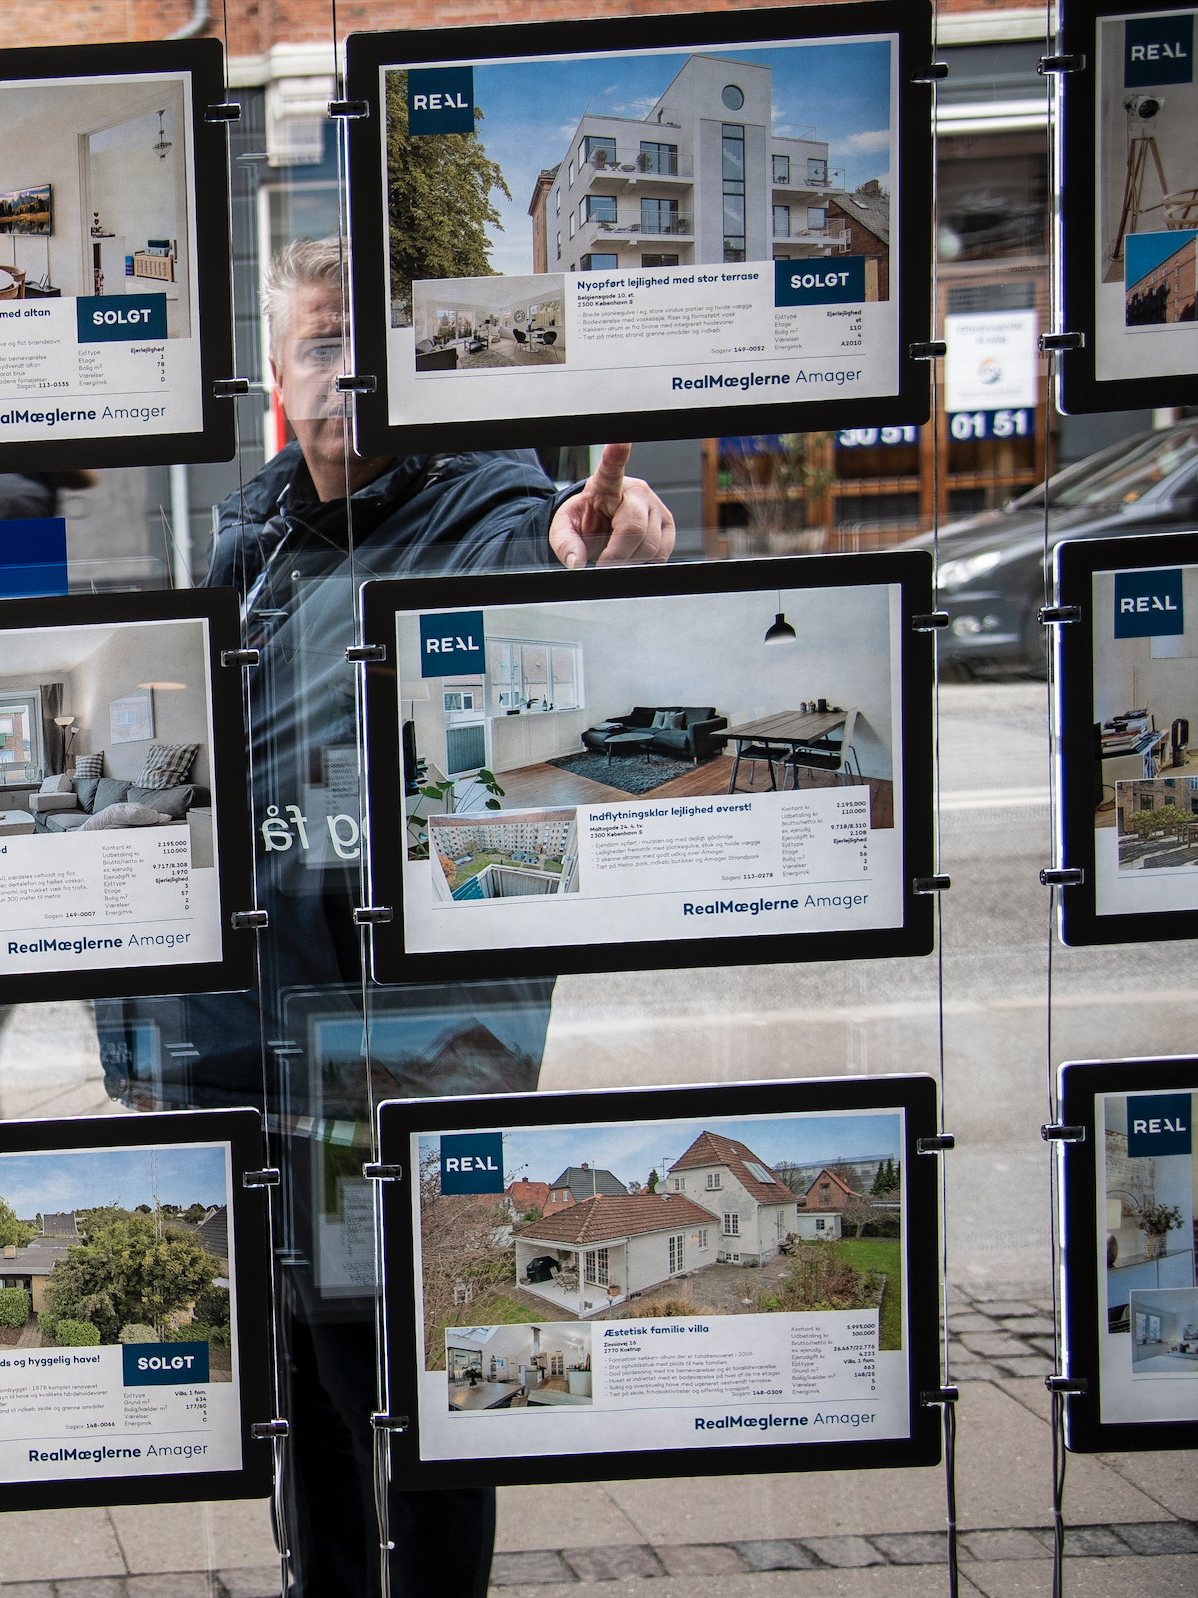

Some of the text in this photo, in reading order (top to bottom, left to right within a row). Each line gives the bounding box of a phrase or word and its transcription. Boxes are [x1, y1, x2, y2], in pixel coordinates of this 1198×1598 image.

[1132, 43, 1186, 61] REAL
[414, 93, 468, 110] REAL
[577, 273, 759, 291] Nyopført lejlighed med stor terrase
[790, 272, 849, 288] SOLGT
[0, 308, 20, 318] med
[23, 308, 50, 317] altan
[92, 308, 151, 325] SOLGT
[672, 370, 861, 390] RealMæglerne Amager
[102, 406, 165, 421] Amager
[951, 412, 986, 440] 01
[993, 409, 1028, 437] 51
[1121, 596, 1177, 613] REAL
[427, 636, 479, 653] REAL
[589, 802, 751, 822] Indflytningsklar lejlighed øverst!
[683, 894, 868, 915] RealMæglerne Amager
[8, 933, 190, 954] RealMæglerne Amager
[1134, 1118, 1186, 1133] REAL
[447, 1157, 498, 1172] REAL
[604, 1324, 708, 1337] Æstetisk familie villa
[13, 1359, 25, 1368] og
[28, 1355, 70, 1366] hyggelig
[73, 1354, 99, 1363] have!
[138, 1355, 194, 1370] SOLGT
[694, 1412, 876, 1430] RealMæglerne Amager
[28, 1444, 207, 1462] RealMæglerne Amager
